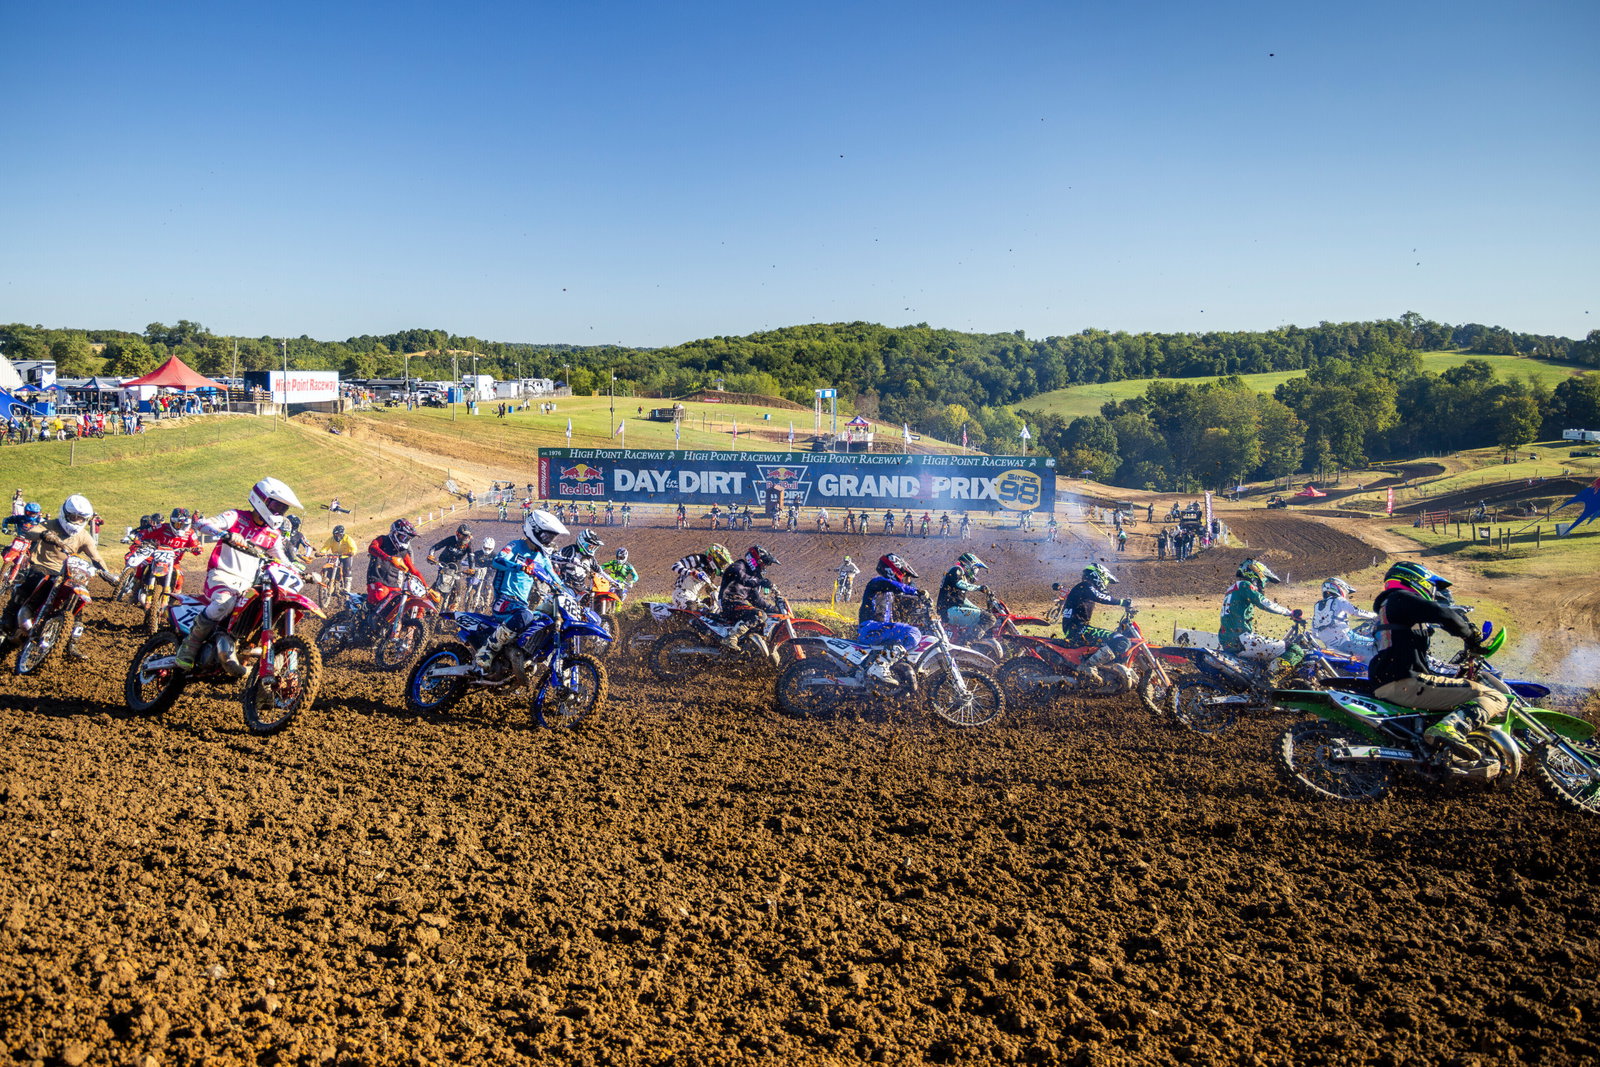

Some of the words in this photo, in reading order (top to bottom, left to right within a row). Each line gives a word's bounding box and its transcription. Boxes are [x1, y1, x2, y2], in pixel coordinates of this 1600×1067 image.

[292, 379, 309, 392] Point
[310, 379, 336, 392] Raceway
[613, 469, 671, 492] DAY
[678, 470, 747, 494] DIRT
[818, 473, 920, 498] GRAND
[931, 476, 1000, 500] PRIX
[1007, 473, 1038, 484] SINCE
[560, 483, 581, 495] Red
[583, 483, 605, 496] Bull
[999, 480, 1039, 505] 98
[278, 569, 301, 593] 72
[177, 608, 200, 627] 72
